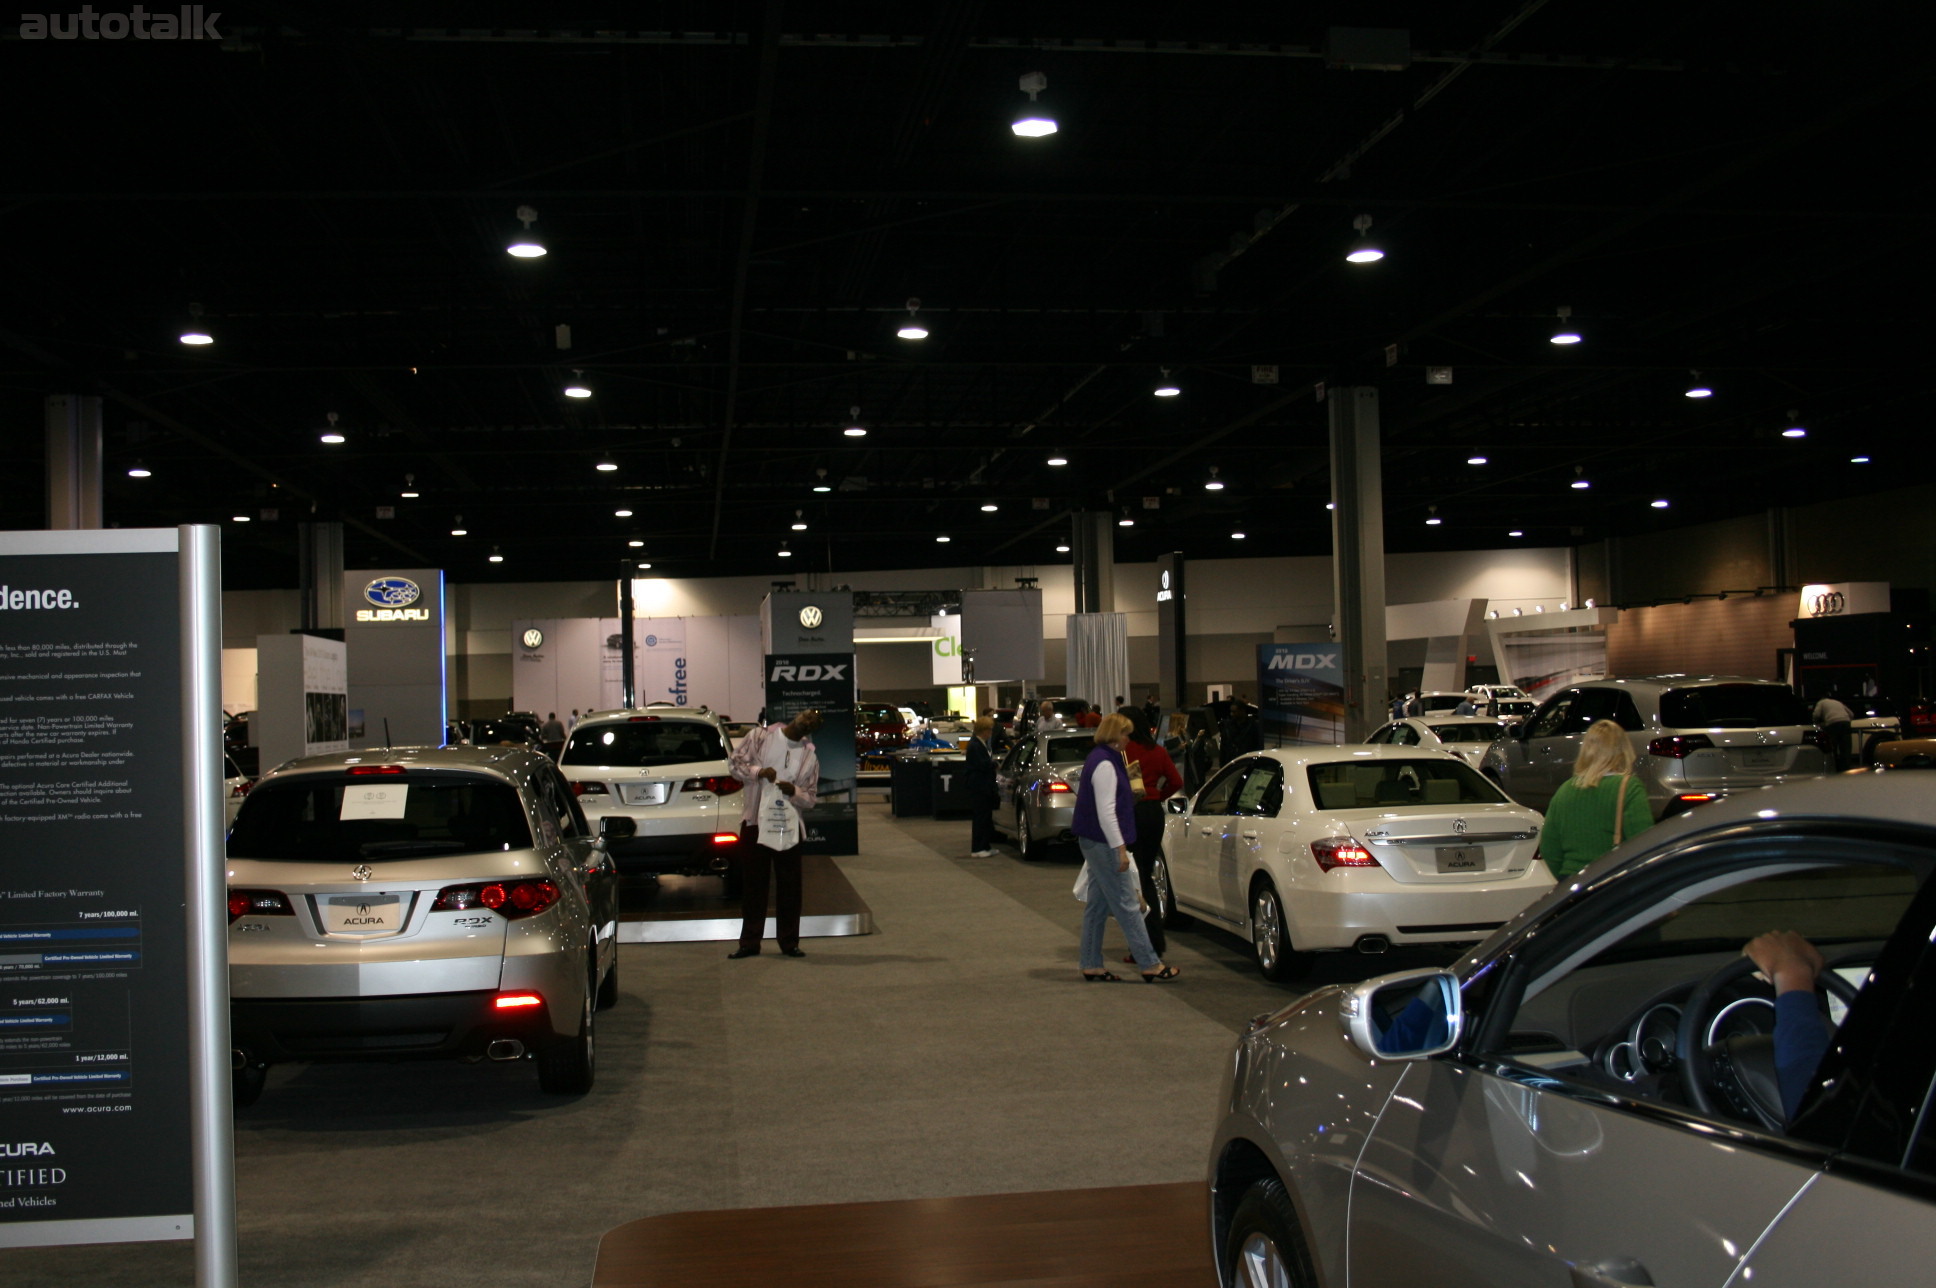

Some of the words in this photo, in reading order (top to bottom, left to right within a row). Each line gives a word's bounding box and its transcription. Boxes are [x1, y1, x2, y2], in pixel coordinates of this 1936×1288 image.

[356, 609, 428, 622] SUBARU
[74, 642, 104, 650] distributed
[105, 642, 127, 650] through
[1268, 654, 1336, 670] MDX
[770, 664, 848, 682] RDX
[71, 780, 96, 788] Certified
[20, 797, 44, 805] Certified
[38, 890, 67, 899] Factory
[85, 910, 128, 919] years/100,000
[344, 917, 384, 925] ACURA
[19, 998, 58, 1006] years/62,000
[81, 1054, 118, 1062] year/12,000
[63, 1105, 132, 1113] www.acura.com
[18, 1196, 56, 1207] Vehicles
